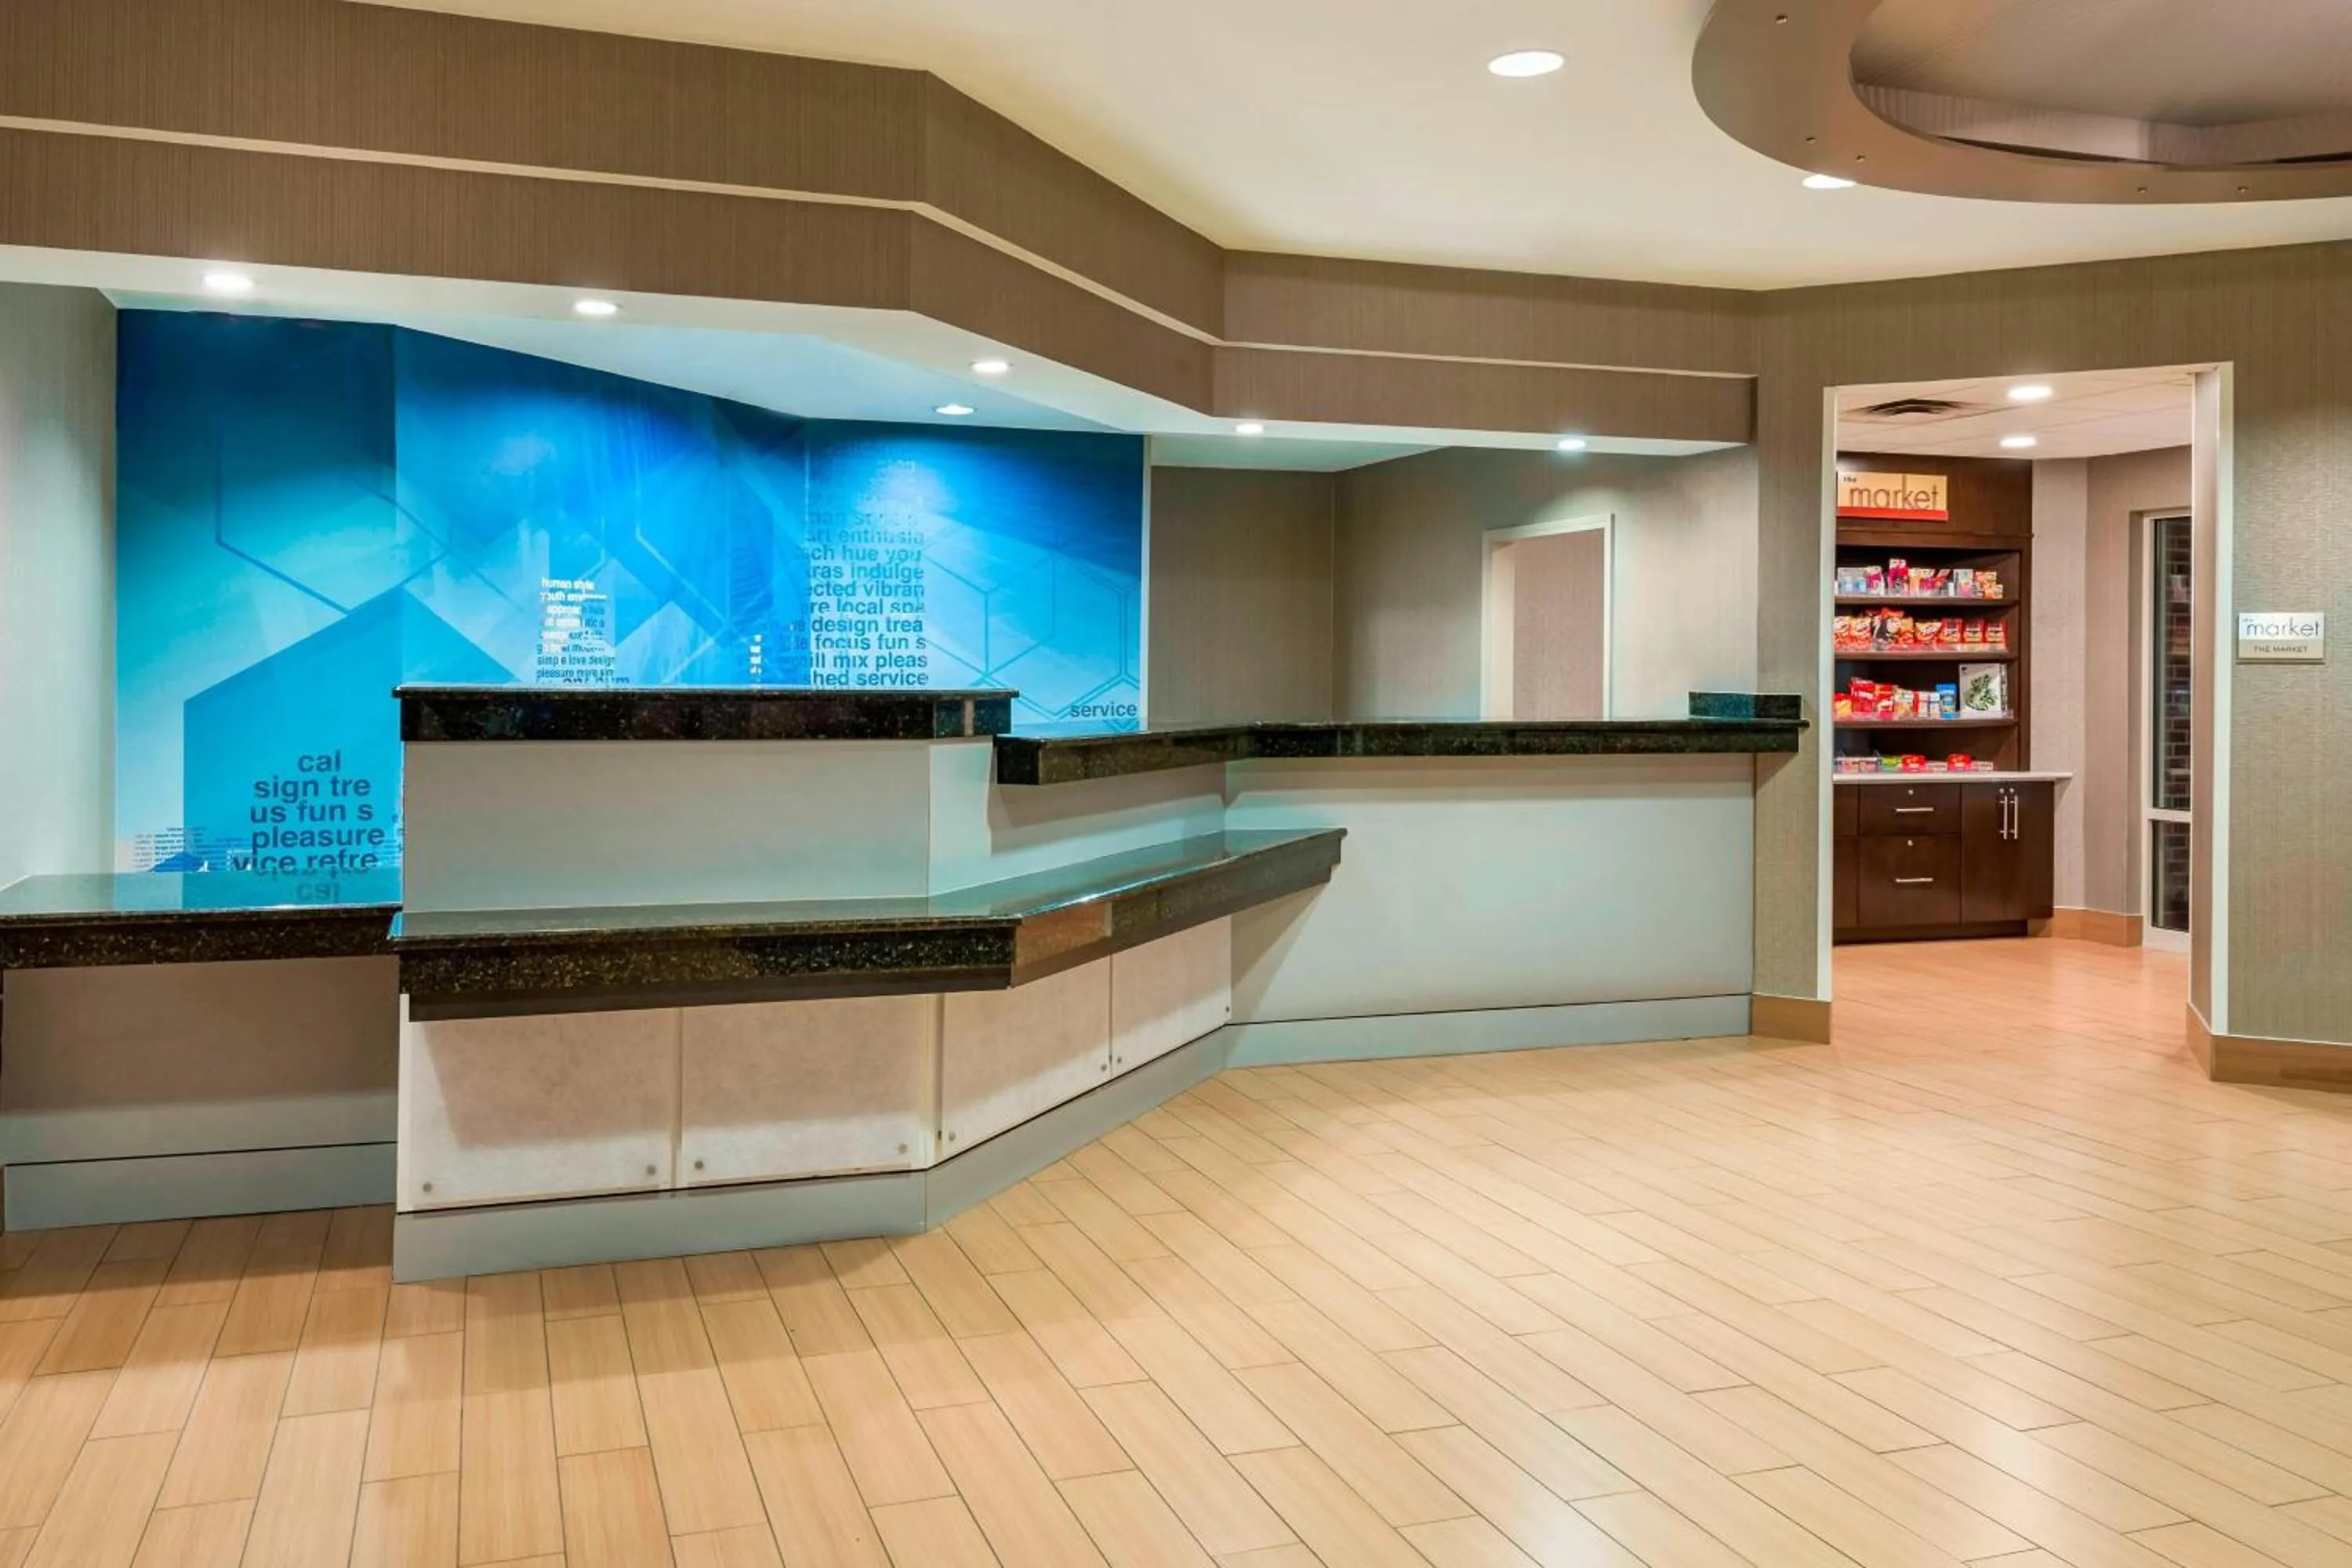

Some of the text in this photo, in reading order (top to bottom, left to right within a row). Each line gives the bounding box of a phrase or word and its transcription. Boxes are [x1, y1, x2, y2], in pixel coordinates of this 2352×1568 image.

[1849, 474, 1940, 510] market
[841, 545, 879, 561] hue
[885, 548, 922, 564] you
[850, 564, 924, 583] indulge
[862, 579, 925, 597] vibran
[837, 599, 884, 615] local
[811, 616, 879, 637] design
[886, 617, 924, 633] trea
[2246, 617, 2320, 637] market
[815, 634, 871, 650] focus
[877, 633, 909, 650] fun
[915, 637, 927, 650] s
[833, 655, 869, 669] mix
[875, 652, 928, 672] pleas
[856, 670, 929, 687] service
[1069, 701, 1138, 717] service
[297, 750, 342, 773] cal
[253, 775, 371, 804] sign tre
[250, 798, 375, 824] us fun s
[252, 825, 386, 856] pleasure
[234, 851, 296, 871] vice
[307, 848, 379, 869] refre
